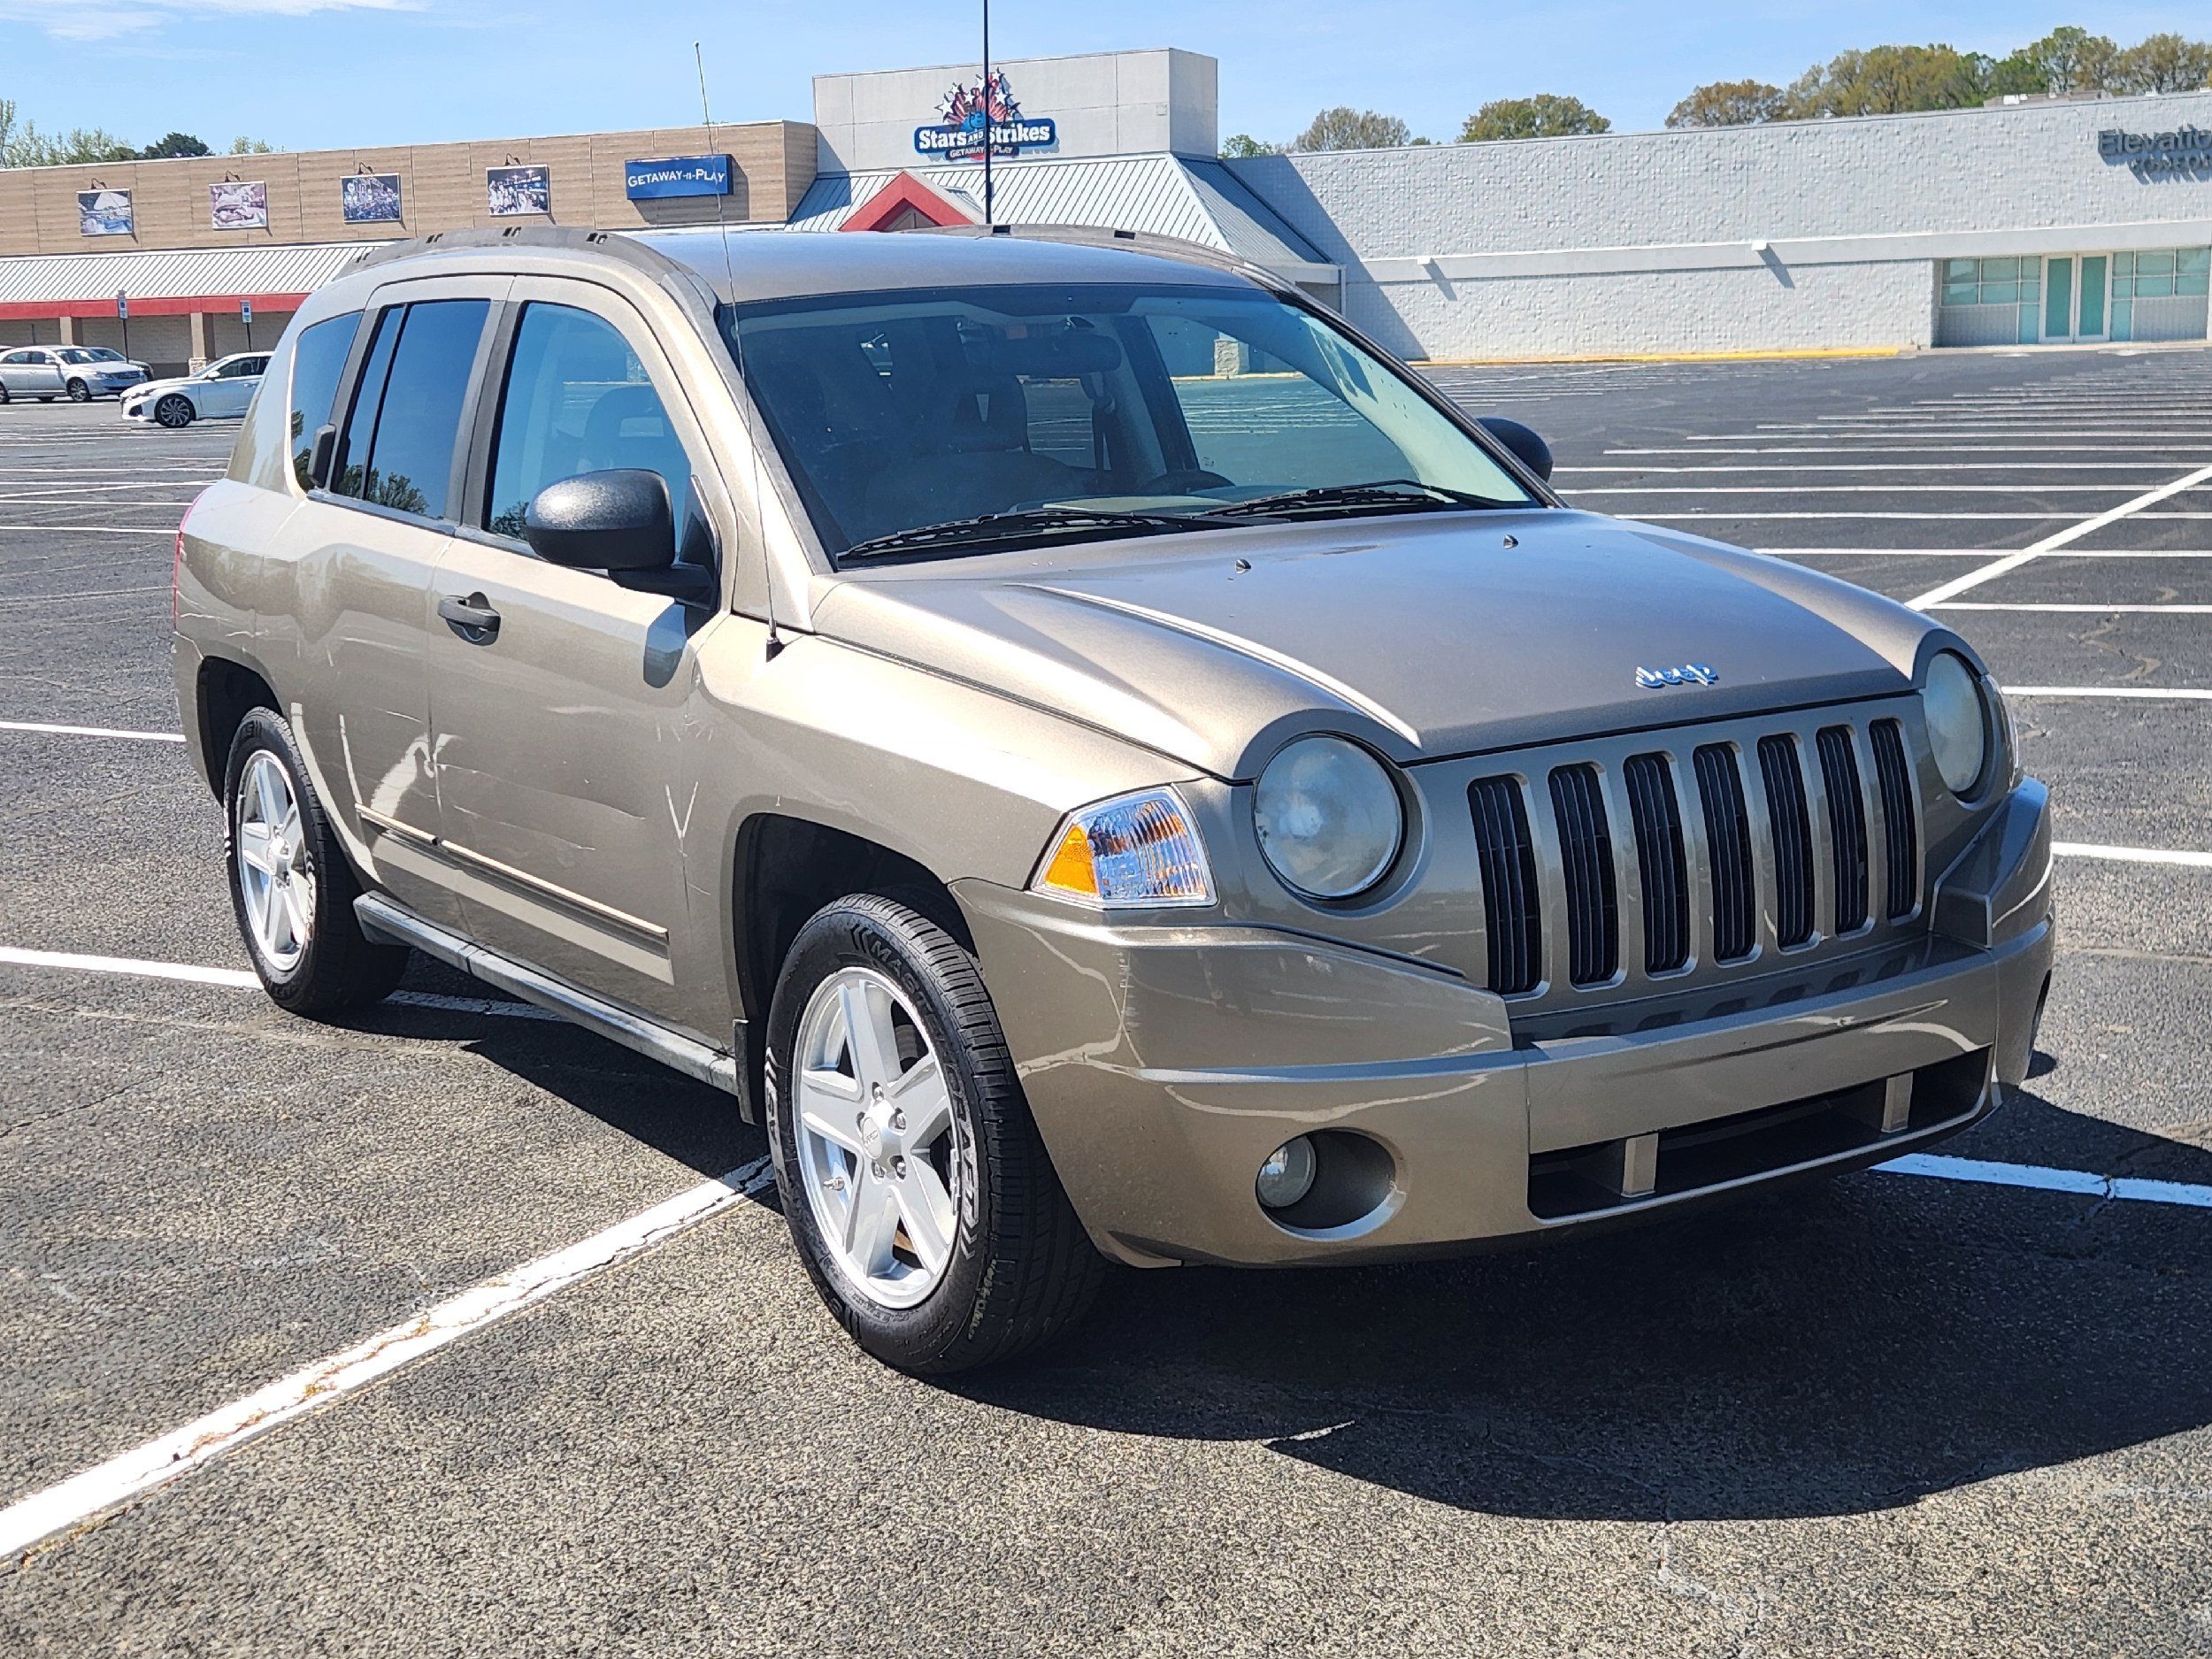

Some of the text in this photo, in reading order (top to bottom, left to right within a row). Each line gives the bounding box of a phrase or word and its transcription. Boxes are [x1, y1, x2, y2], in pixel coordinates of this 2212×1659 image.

[918, 123, 1050, 150] Stars AND Strikes
[1635, 664, 1718, 687] Jeep
